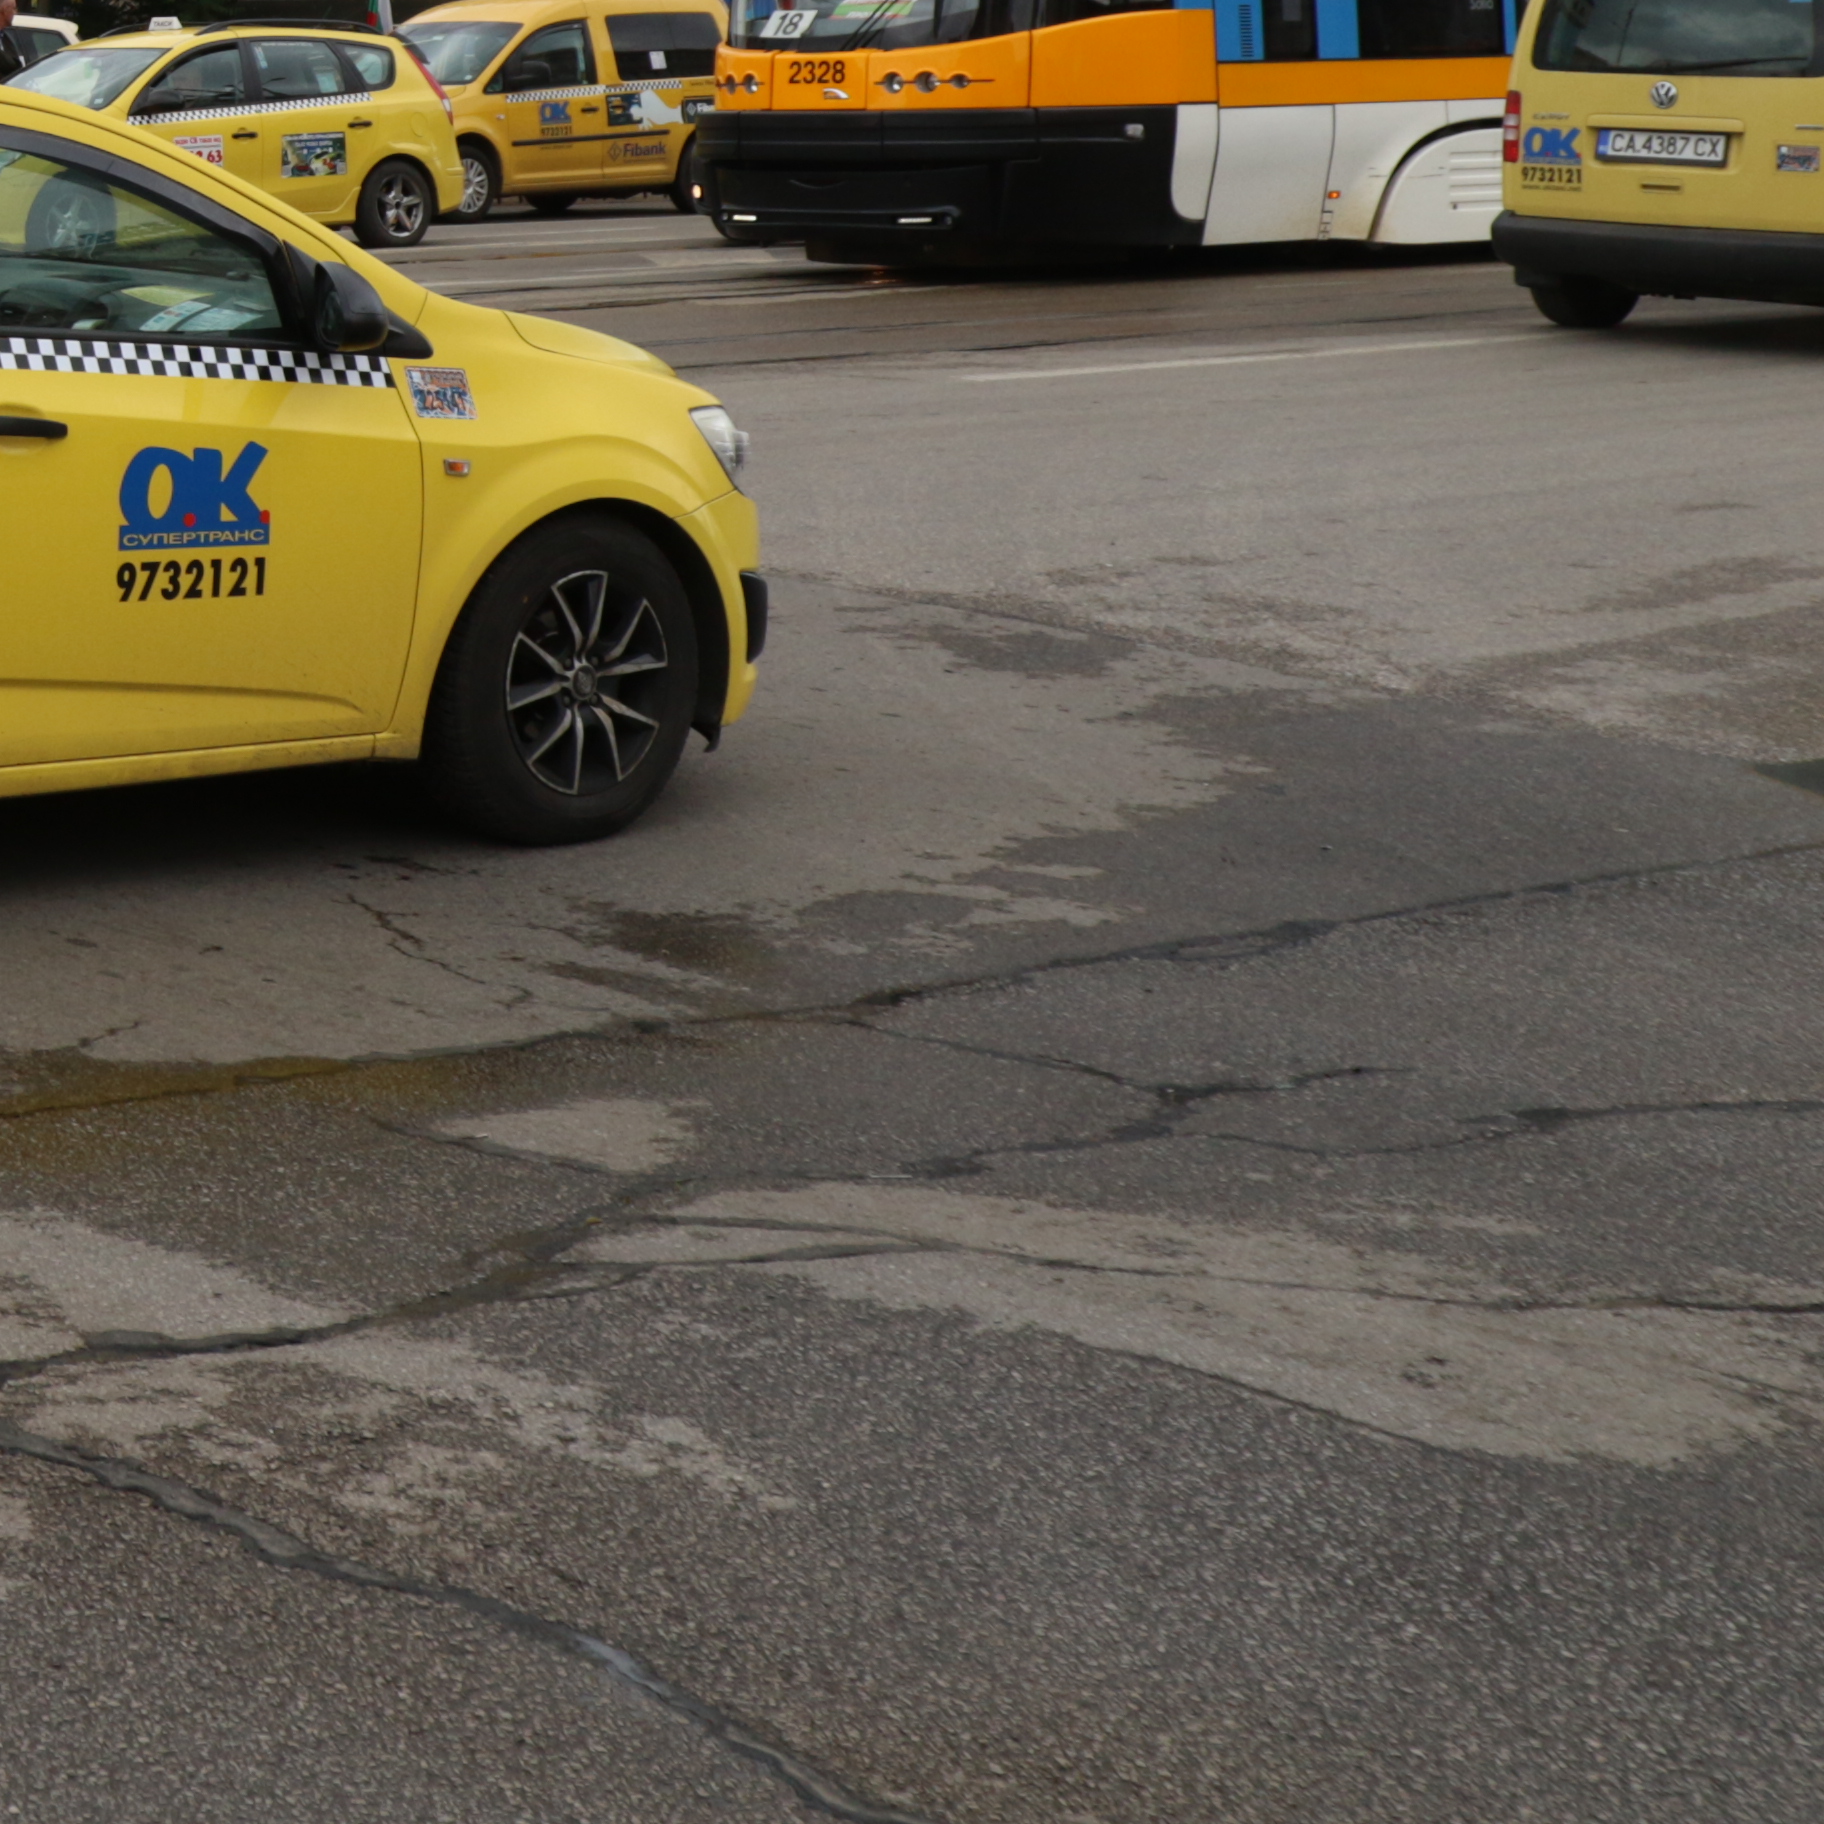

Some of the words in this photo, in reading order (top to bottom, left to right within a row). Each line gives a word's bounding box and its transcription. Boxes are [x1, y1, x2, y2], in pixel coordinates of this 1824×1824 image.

[773, 12, 804, 36] 18
[788, 60, 846, 85] 2328
[623, 141, 667, 157] Fibank
[1521, 166, 1582, 184] 9732121
[122, 528, 265, 548] СУПЕРТРАНС
[116, 556, 266, 603] 9732121
